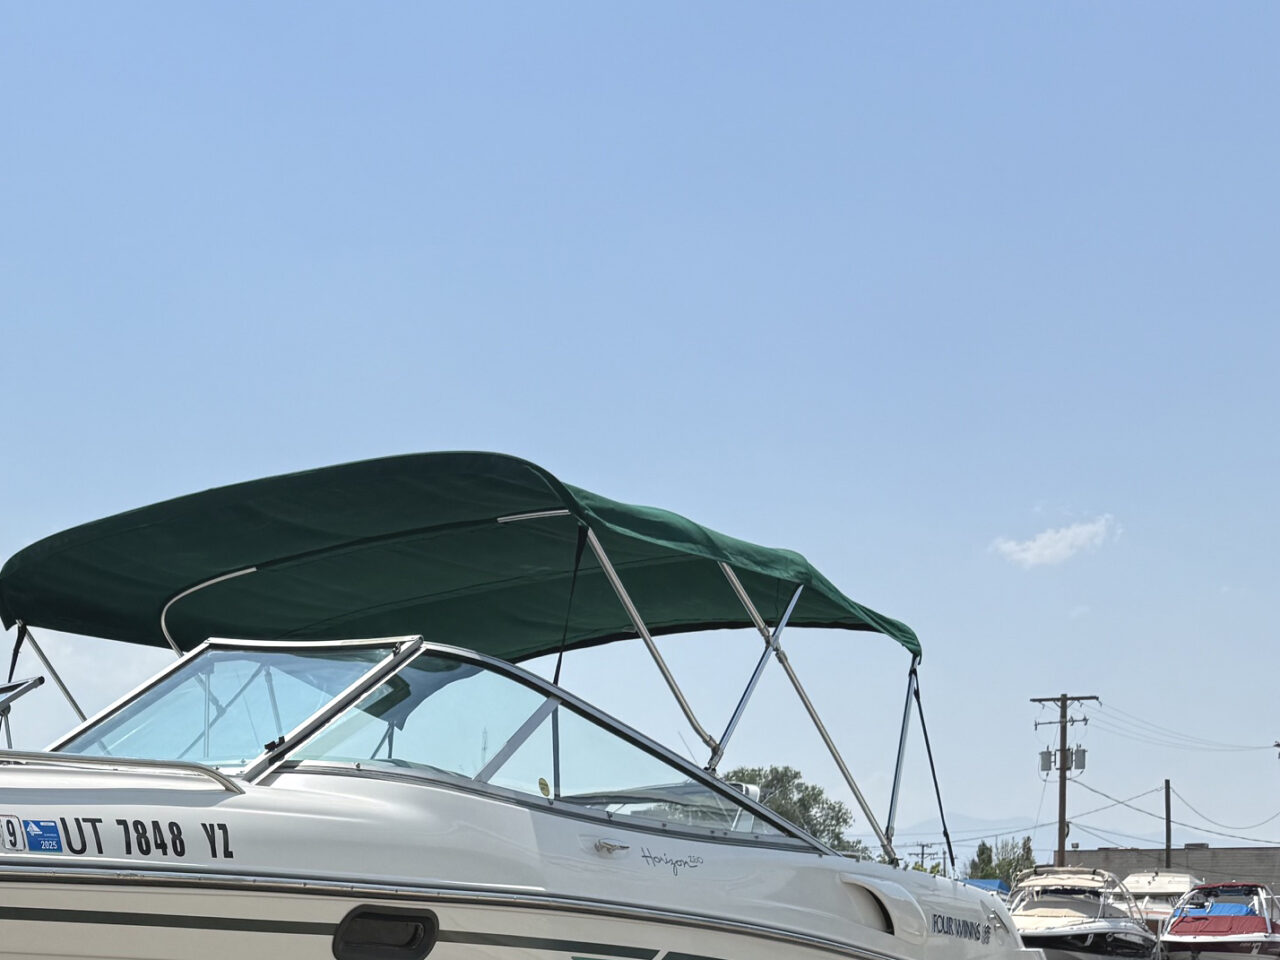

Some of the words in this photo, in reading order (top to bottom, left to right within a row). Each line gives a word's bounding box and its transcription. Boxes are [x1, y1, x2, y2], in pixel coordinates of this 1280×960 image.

[6, 819, 17, 848] 9
[40, 841, 58, 850] 2025
[60, 817, 103, 855] UT
[115, 819, 186, 857] 7848
[200, 822, 234, 859] YZ
[641, 847, 698, 876] Horizon
[932, 914, 954, 935] FOUR
[954, 918, 981, 941] WINNS
